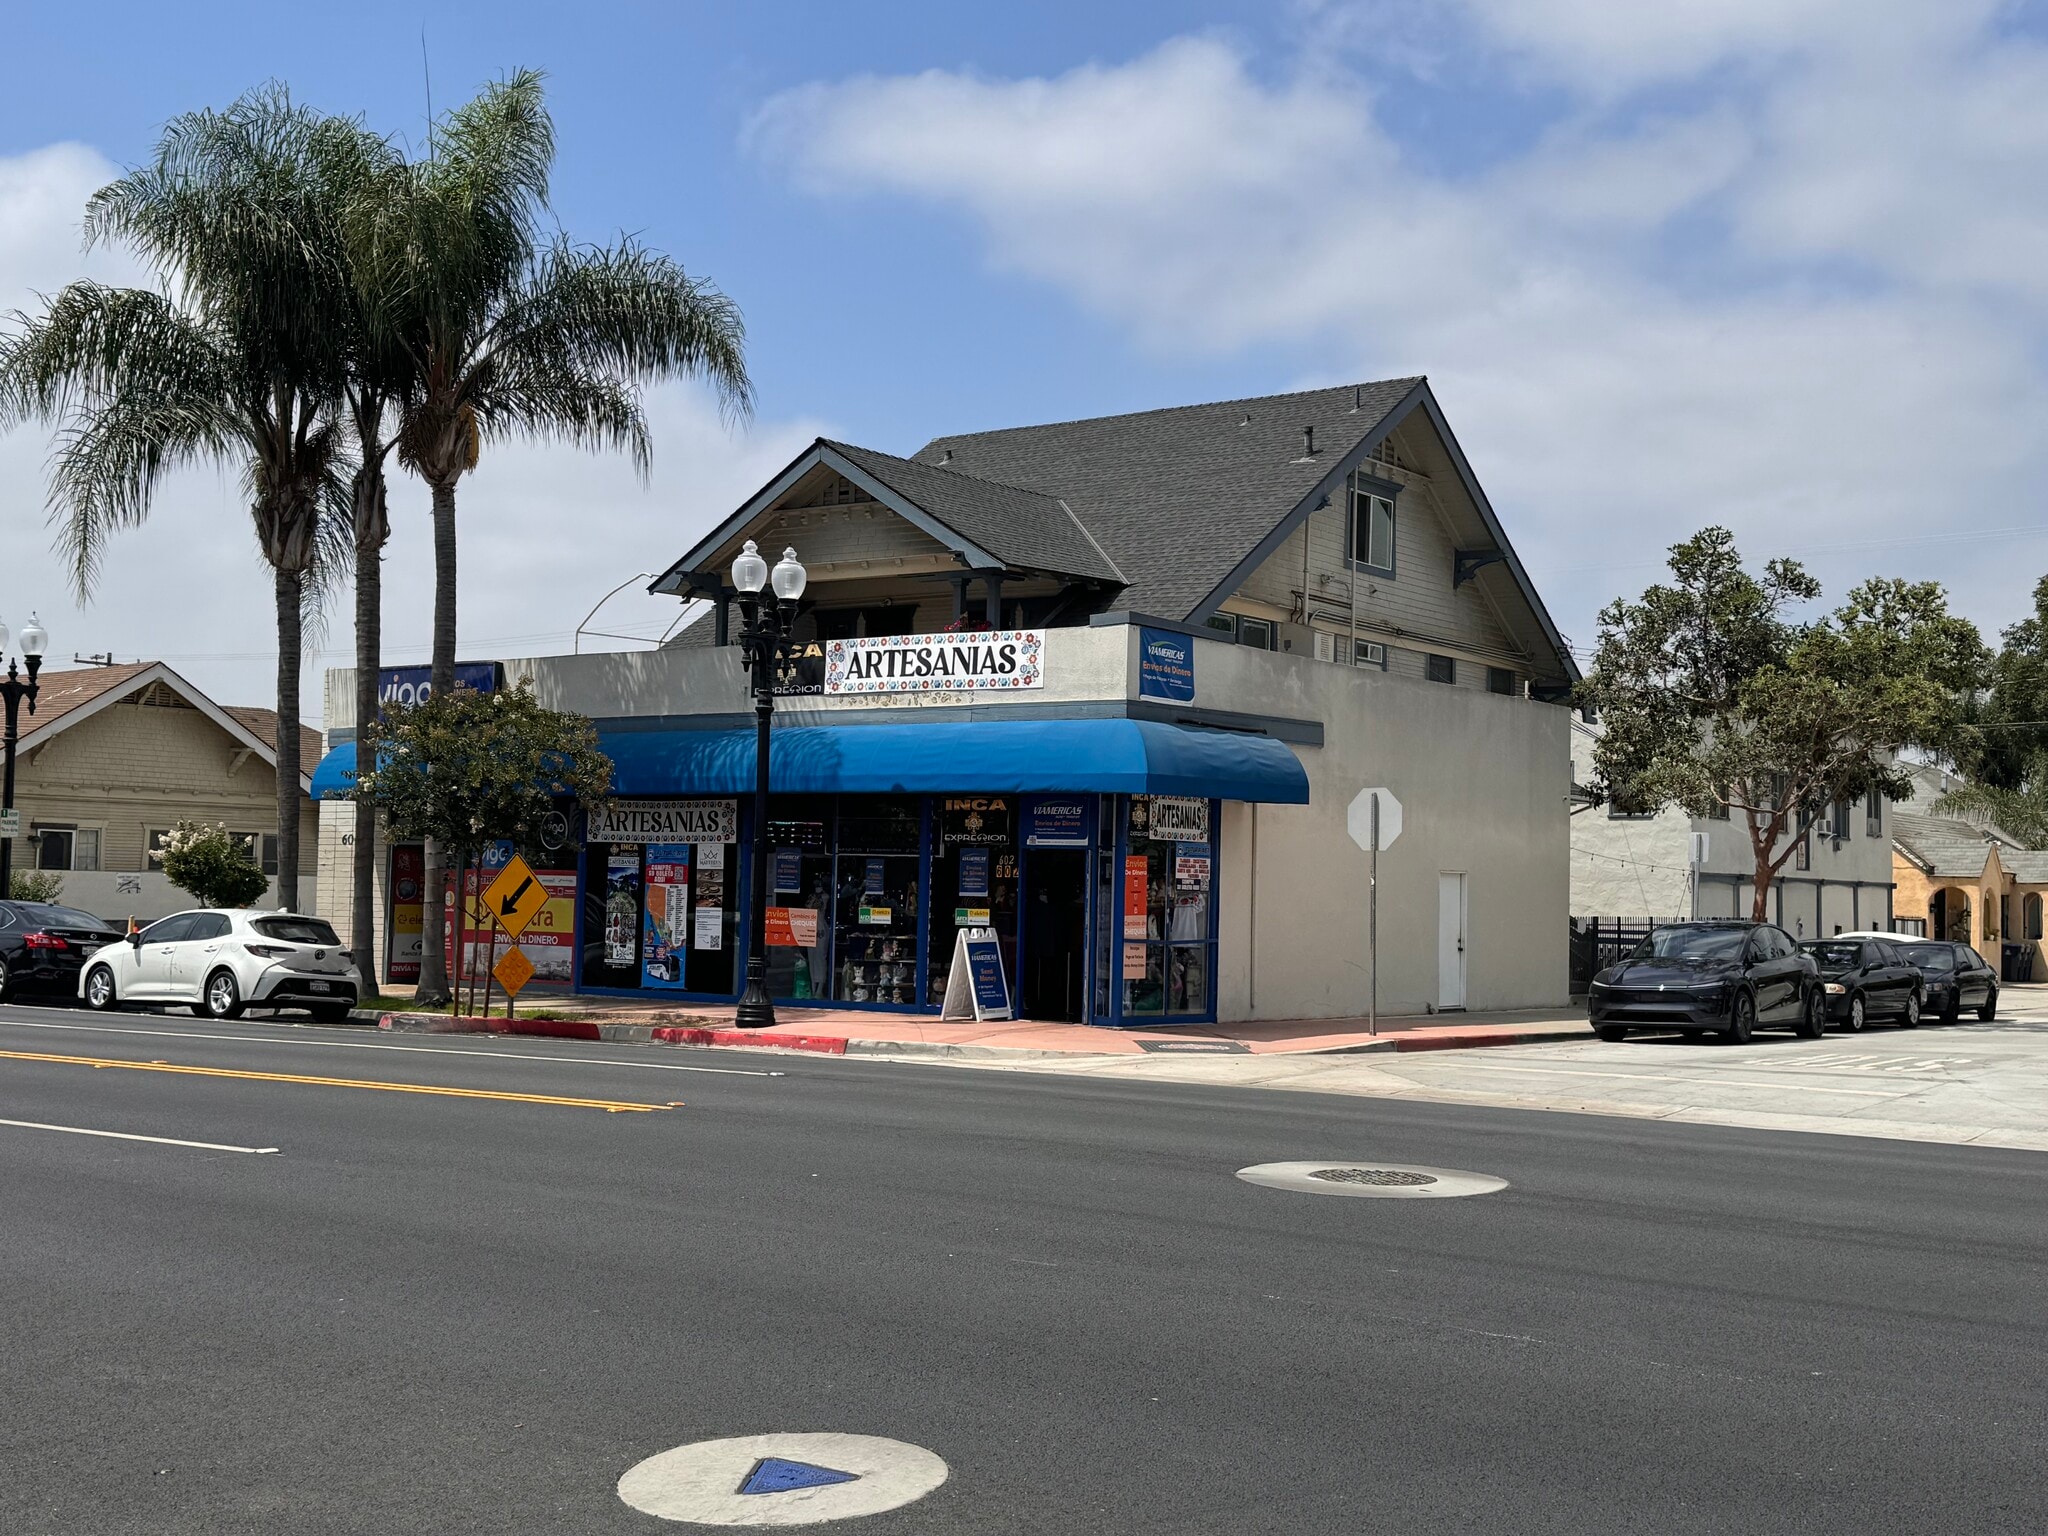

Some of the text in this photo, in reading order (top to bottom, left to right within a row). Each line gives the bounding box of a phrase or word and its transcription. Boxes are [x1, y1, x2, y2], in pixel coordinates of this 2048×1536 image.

[1147, 644, 1186, 661] VIAMERICAS
[844, 644, 1017, 680] ARTESANIAS
[1172, 665, 1192, 677] Dinero
[945, 799, 1007, 811] INCA
[1033, 805, 1083, 815] VIAMERICAS
[602, 810, 719, 833] ARTESANIAS
[1154, 803, 1202, 830] ARTESANIAS
[998, 854, 1015, 865] 602
[494, 933, 514, 944] ENV
[528, 934, 559, 945] DINERO
